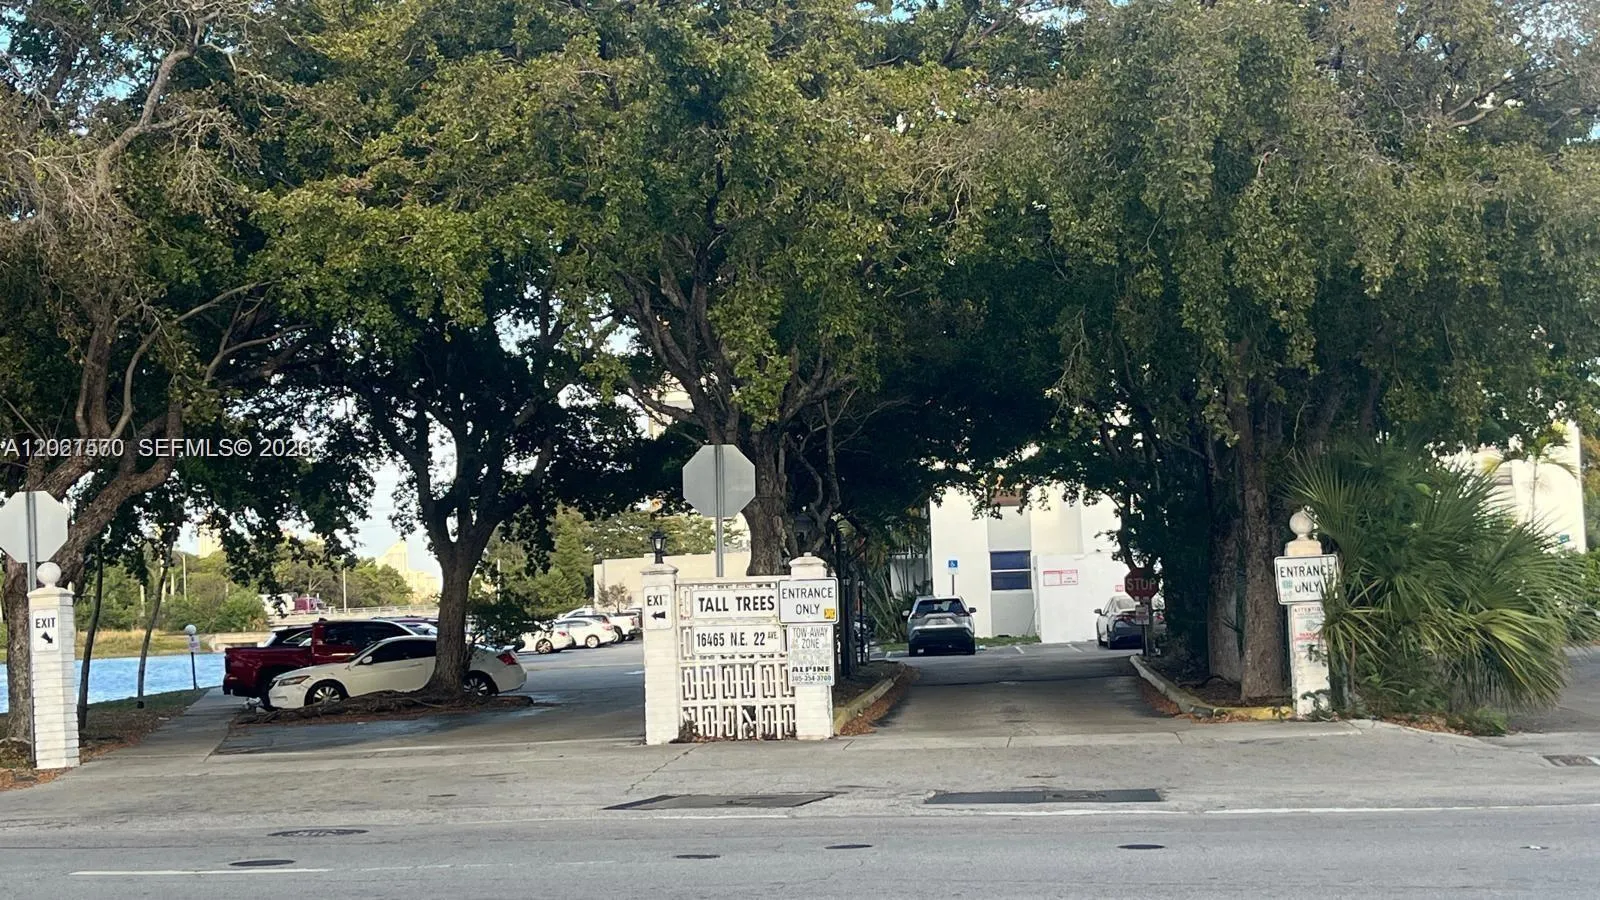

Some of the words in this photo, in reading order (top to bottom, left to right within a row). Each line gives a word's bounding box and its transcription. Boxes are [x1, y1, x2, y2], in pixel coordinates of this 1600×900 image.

[1280, 565, 1334, 578] ENTRANCE
[1127, 578, 1157, 591] STOP
[1295, 581, 1321, 593] ONLY
[782, 587, 833, 599] ENTRANCE
[698, 596, 729, 612] TALL
[736, 595, 775, 611] TREES
[795, 604, 820, 615] ONLY
[35, 617, 56, 628] EXIT
[696, 632, 725, 647] 16465
[730, 632, 748, 647] N.E.
[754, 632, 766, 646] 22
[801, 639, 820, 649] ZONE
